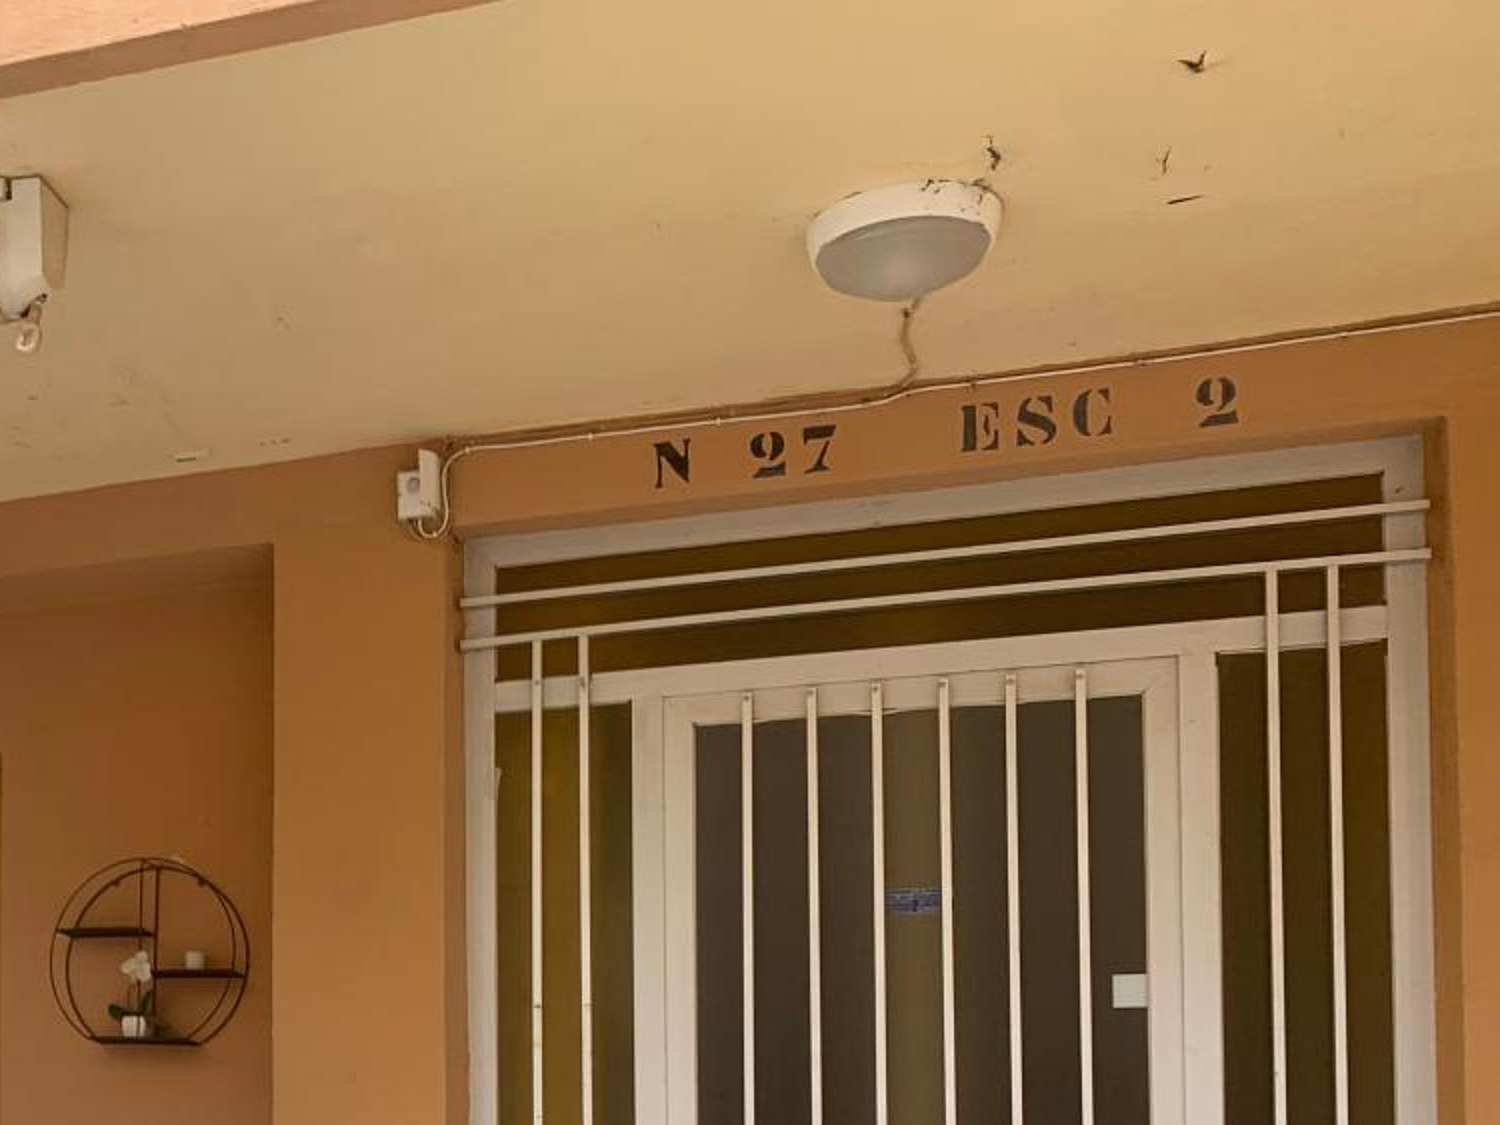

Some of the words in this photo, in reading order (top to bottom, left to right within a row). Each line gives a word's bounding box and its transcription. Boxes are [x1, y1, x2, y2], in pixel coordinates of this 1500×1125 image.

[653, 438, 691, 489] N
[750, 424, 837, 479] 27
[960, 386, 1113, 453] ESC
[1195, 377, 1239, 428] 2
